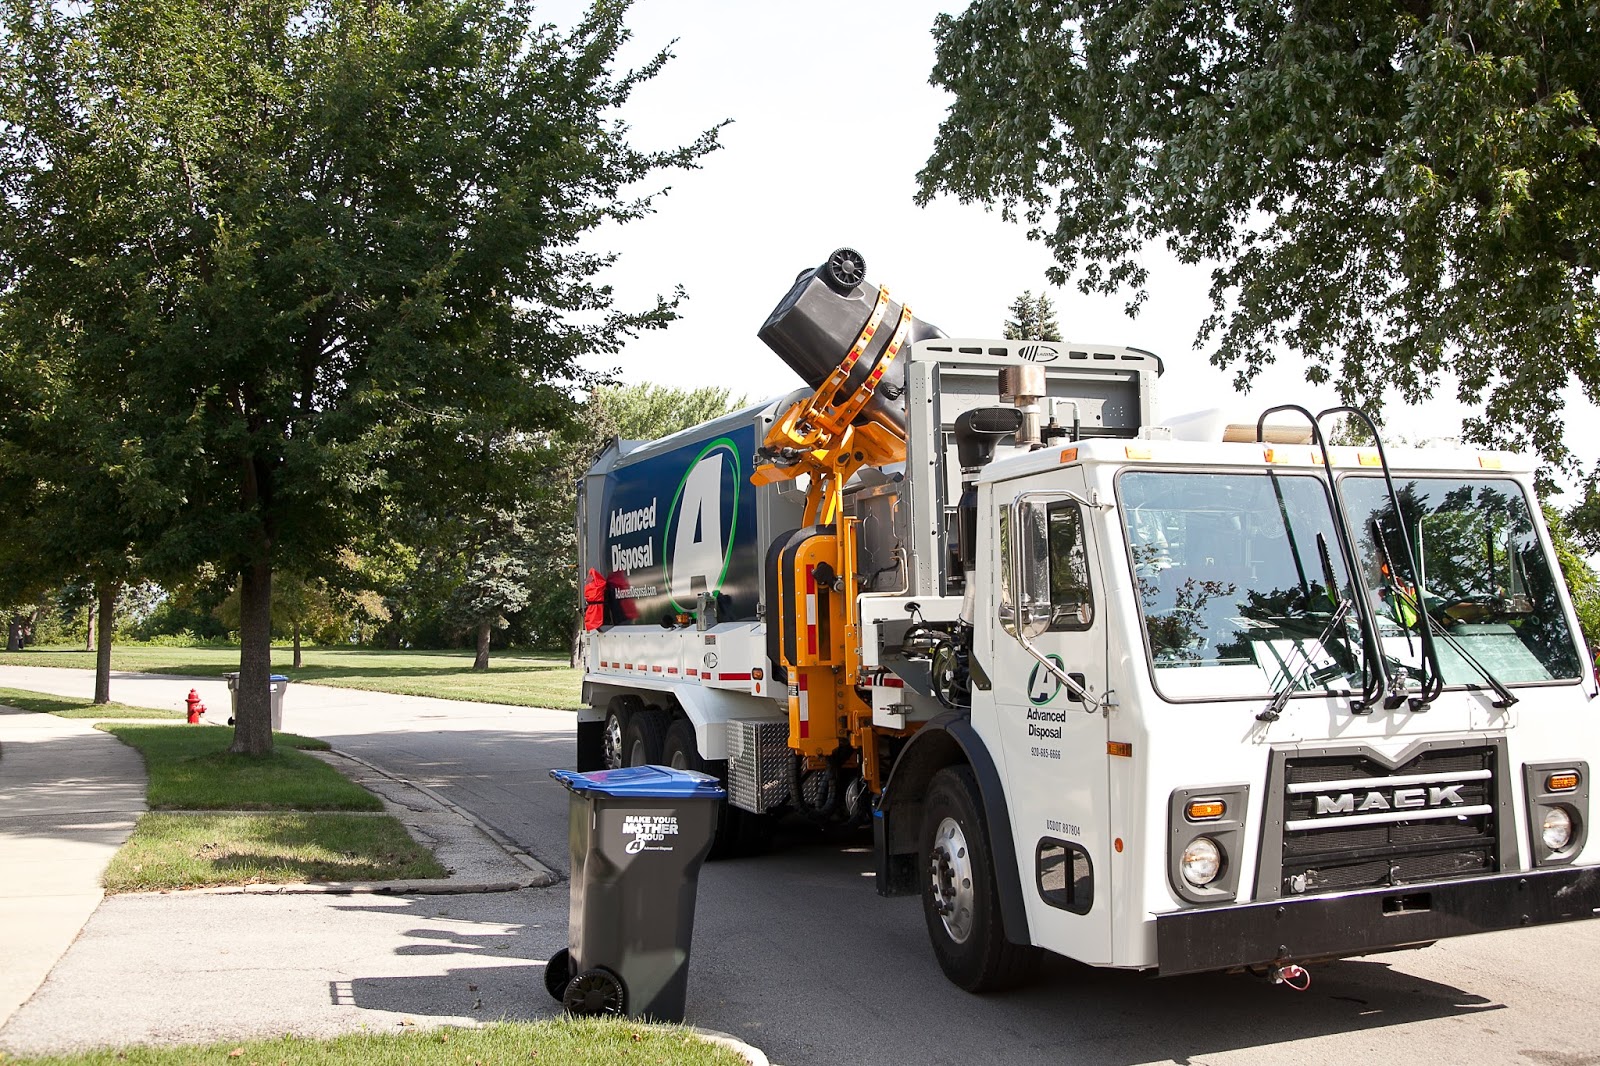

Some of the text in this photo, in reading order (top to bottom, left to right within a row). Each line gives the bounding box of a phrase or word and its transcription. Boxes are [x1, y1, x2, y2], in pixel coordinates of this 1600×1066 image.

[609, 497, 657, 538] Advanced
[611, 536, 653, 577] Disposal
[1027, 708, 1066, 723] Advanced
[1028, 724, 1062, 740] Disposal
[1315, 784, 1466, 815] MACK
[652, 816, 677, 824] YOUR
